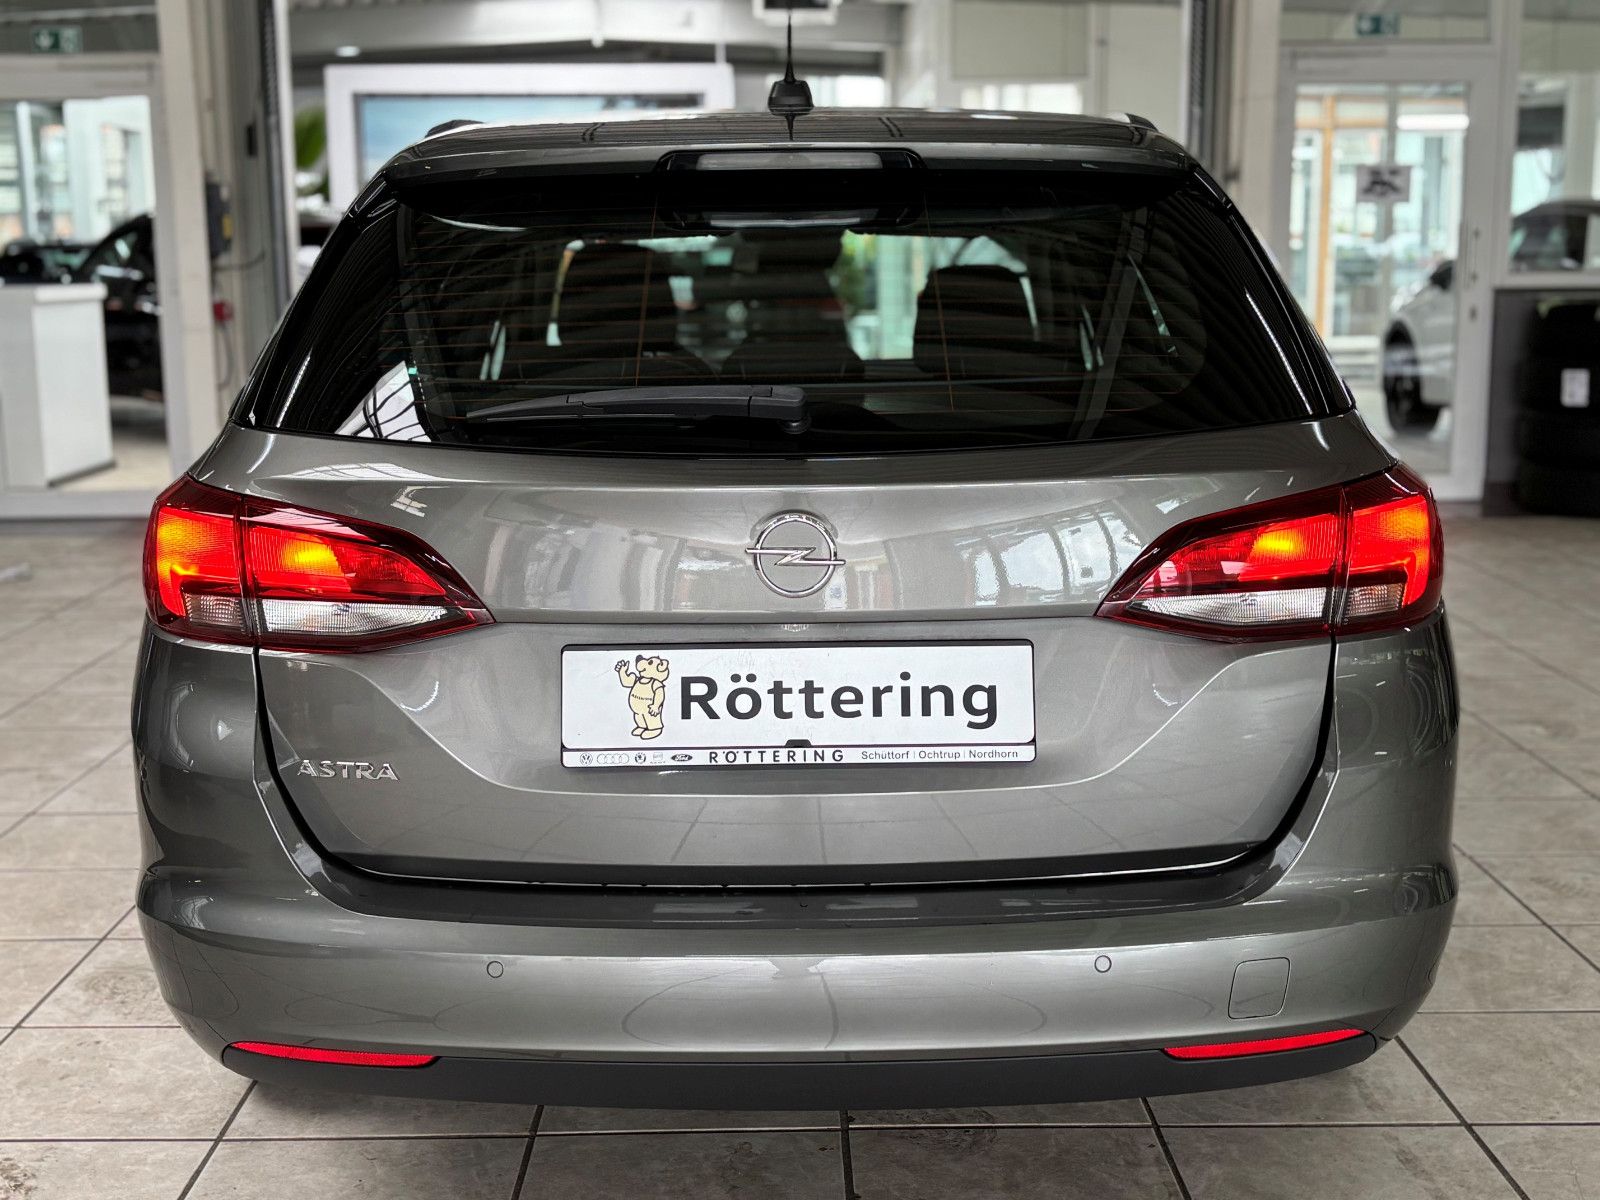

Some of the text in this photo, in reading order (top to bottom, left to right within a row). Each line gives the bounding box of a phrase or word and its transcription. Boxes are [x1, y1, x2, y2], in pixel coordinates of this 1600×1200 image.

[681, 671, 998, 729] Röttering
[709, 750, 844, 763] RÖTTERING
[918, 749, 961, 760] Ochtrup
[968, 749, 1018, 759] Nordhorn
[297, 759, 399, 781] ASTRA
